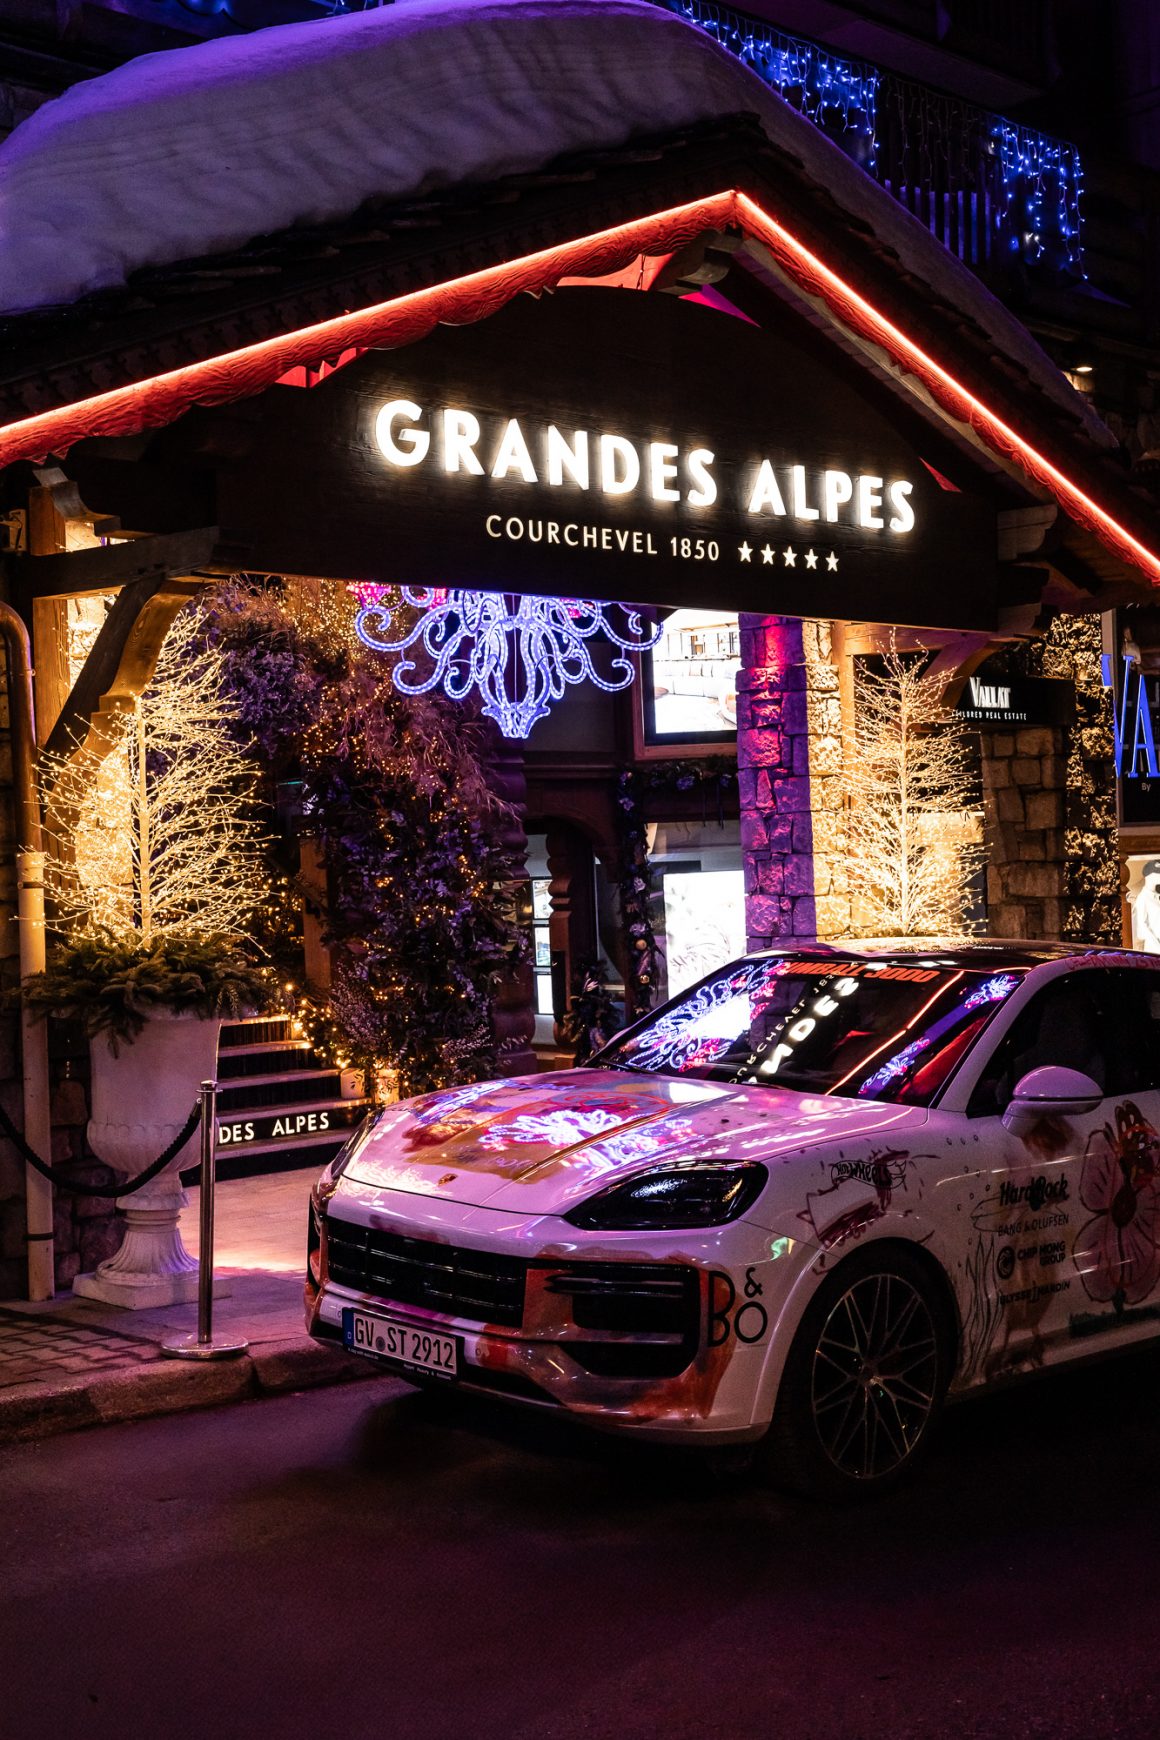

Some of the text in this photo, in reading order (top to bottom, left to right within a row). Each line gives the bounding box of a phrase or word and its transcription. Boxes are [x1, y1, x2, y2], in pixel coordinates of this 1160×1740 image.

[375, 400, 915, 533] GRANDES ALPES
[486, 514, 720, 562] COURCHEVEL 1850
[985, 711, 1001, 720] REAL
[1004, 712, 1027, 721] ESTATE
[1141, 782, 1152, 793] By
[782, 961, 940, 983] UMBALL 3000
[272, 1112, 329, 1136] ALPES
[1000, 1173, 1069, 1206] Hard Rock
[998, 1221, 1022, 1236] BANG
[1031, 1214, 1069, 1229] OLUFSEN
[1018, 1246, 1038, 1260] CHIP
[355, 1318, 374, 1347] GV
[387, 1327, 407, 1354] ST
[412, 1333, 454, 1369] 2912
